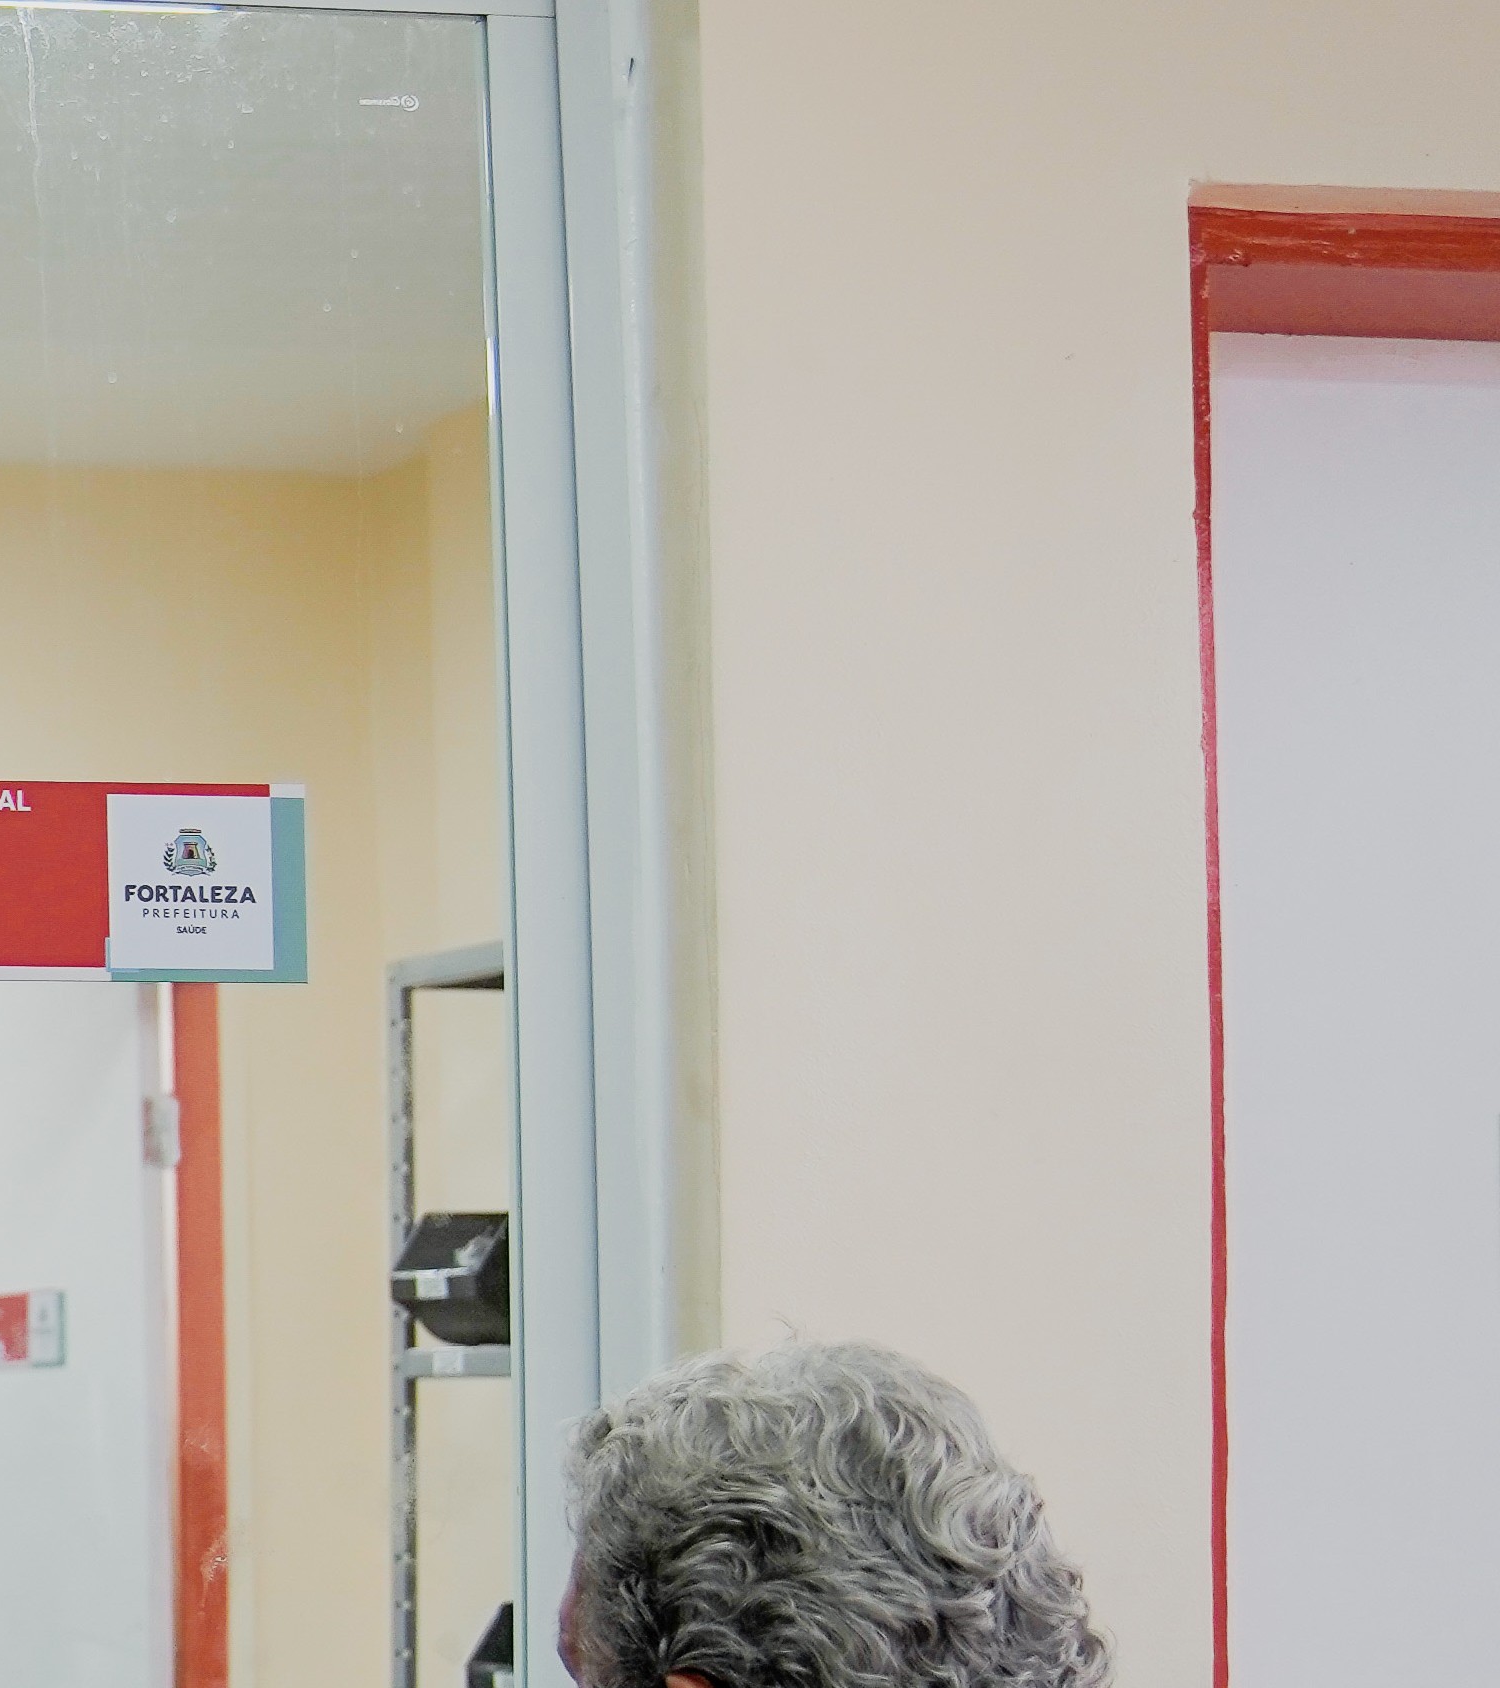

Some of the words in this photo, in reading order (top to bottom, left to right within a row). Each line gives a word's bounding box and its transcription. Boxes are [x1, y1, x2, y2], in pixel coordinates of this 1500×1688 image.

[124, 884, 257, 904] FORTALEZA
[142, 908, 240, 919] PREFEITURA
[176, 924, 207, 934] SAÚDE
